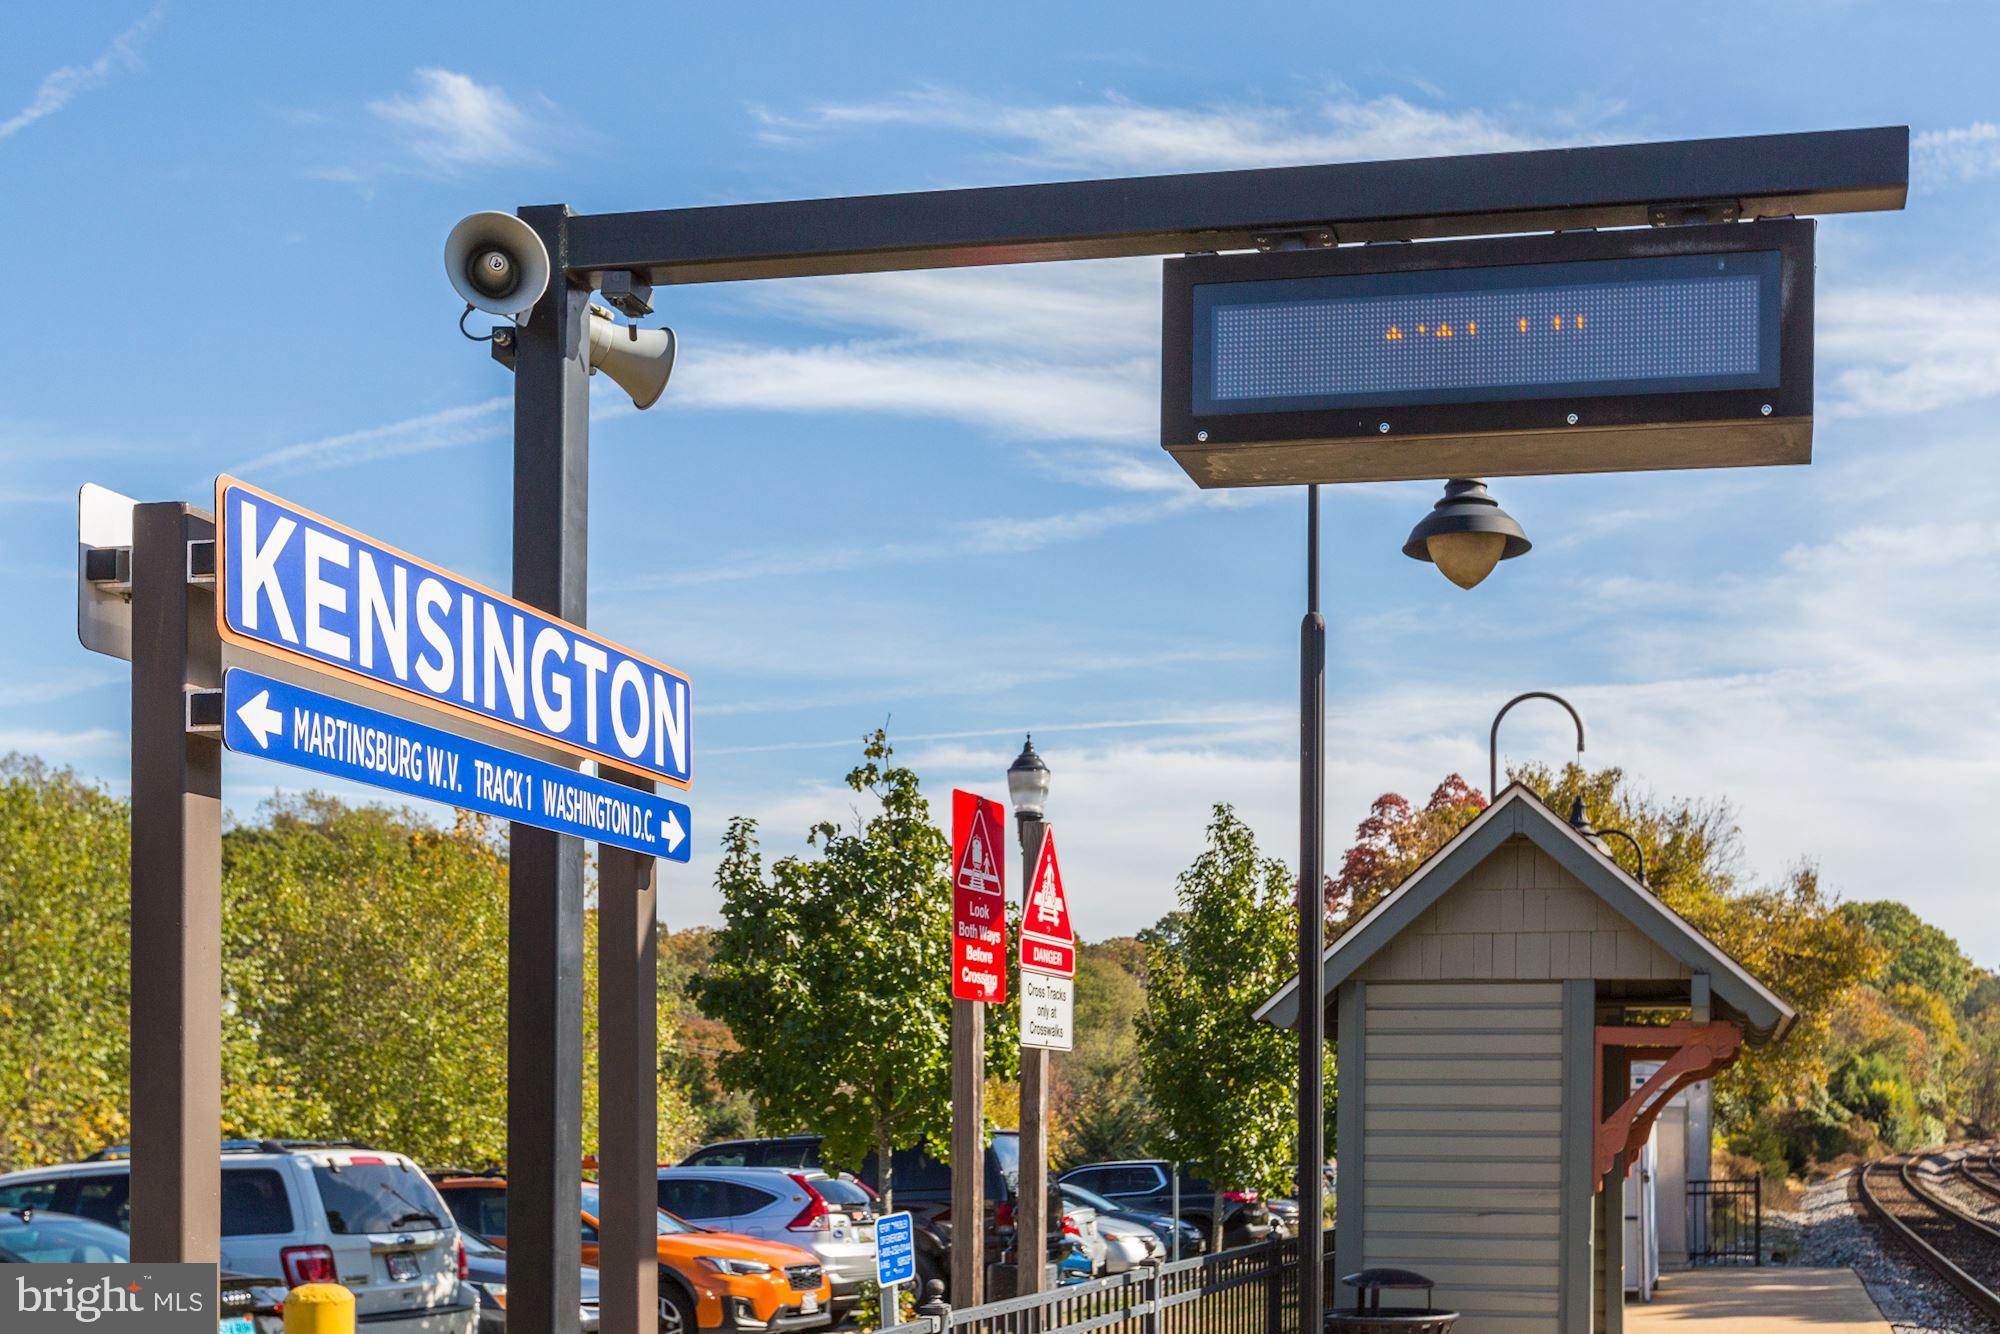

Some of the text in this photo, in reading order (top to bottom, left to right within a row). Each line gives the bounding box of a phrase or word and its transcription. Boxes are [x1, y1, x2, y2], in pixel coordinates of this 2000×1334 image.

[240, 499, 686, 774] KENSINGTON
[293, 706, 655, 843] MARTINSBURG W.V. TRACK 1 WASHINGTON D.C.
[969, 901, 990, 920] Look
[958, 920, 1001, 945] Both Ways
[965, 944, 994, 964] Before
[1032, 945, 1063, 967] DANGER
[961, 965, 998, 993] Crossing
[1027, 981, 1067, 1002] Cross Tracks
[1036, 1004, 1057, 1020] only at
[1029, 1020, 1064, 1039] Crosswalks
